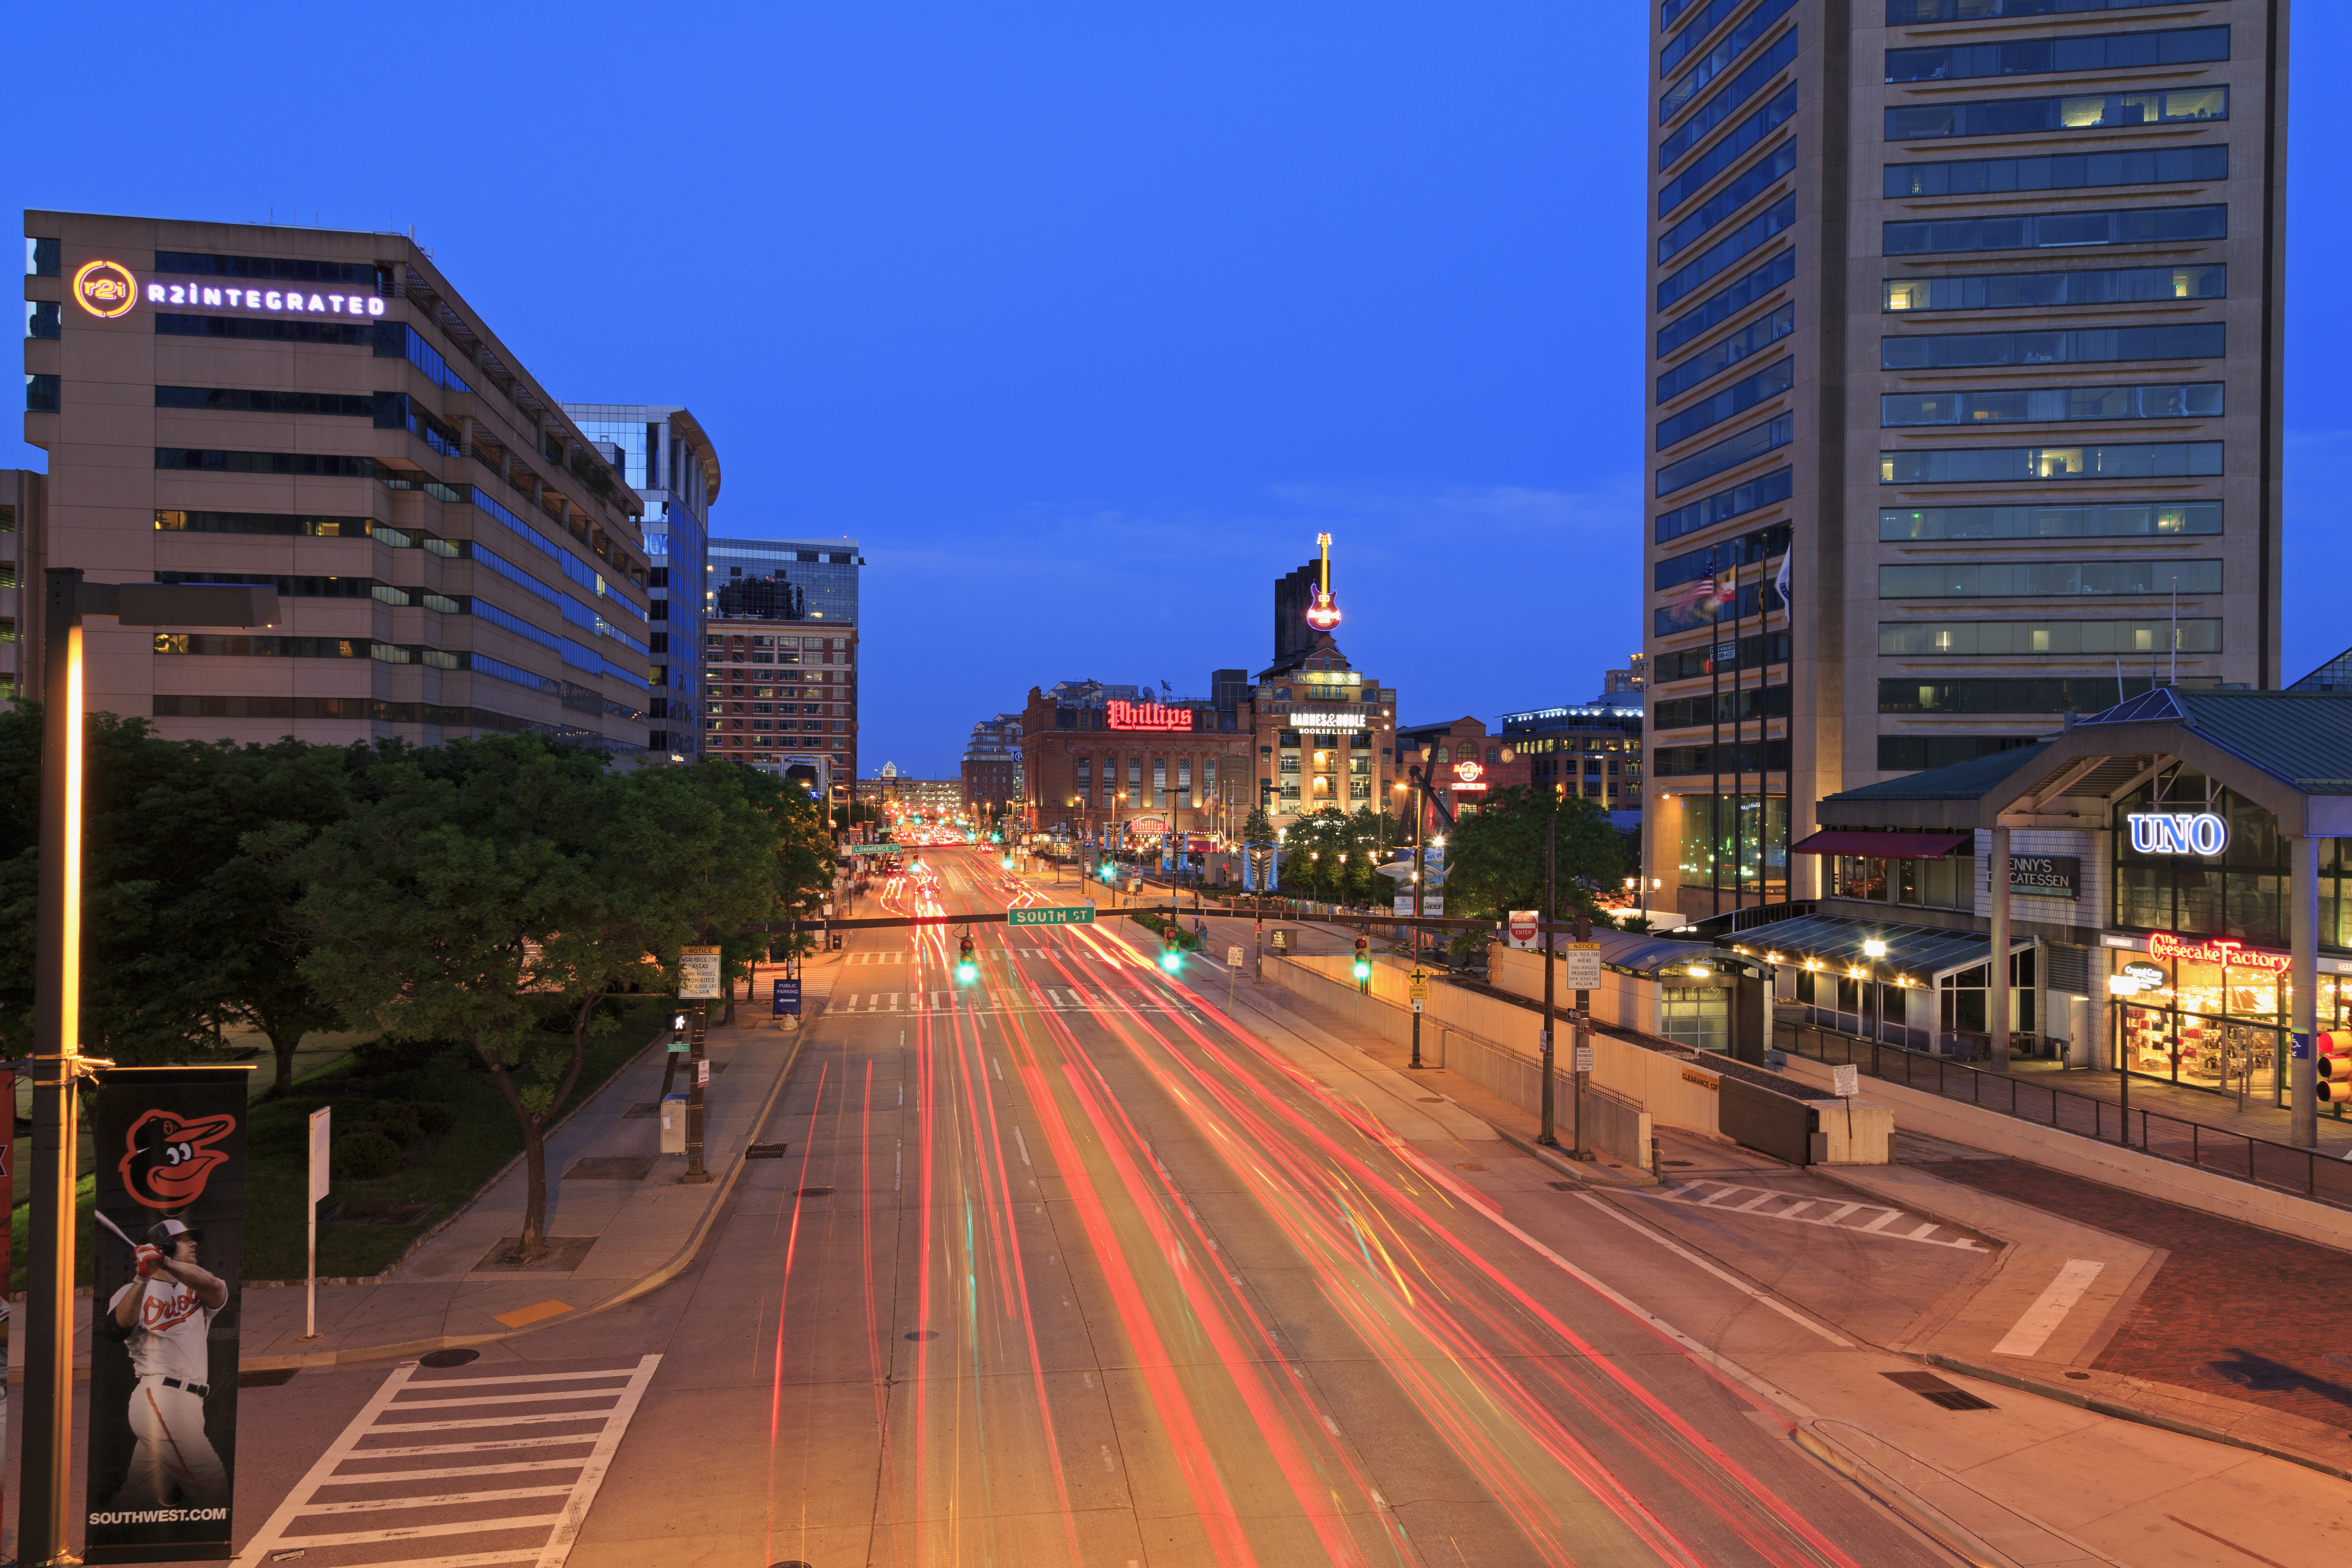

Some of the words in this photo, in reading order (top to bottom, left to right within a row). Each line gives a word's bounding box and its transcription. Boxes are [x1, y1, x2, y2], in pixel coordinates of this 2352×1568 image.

[1297, 674, 1327, 682] POWER
[1107, 700, 1192, 730] Phillips
[1131, 819, 1169, 832] Phillips
[2127, 814, 2225, 855] UNO
[1427, 852, 1442, 860] NEW
[2009, 858, 2052, 873] ENNY'S
[1017, 910, 1066, 922] SOUTH
[1073, 910, 1087, 920] ST
[2164, 935, 2178, 945] The
[2149, 933, 2221, 962] Cheesecake
[2212, 940, 2292, 975] Factory
[2337, 962, 2352, 972] BAKE
[1682, 1073, 1709, 1088] CLEARANCE
[89, 1508, 227, 1525] SOUTHWEST.COM
